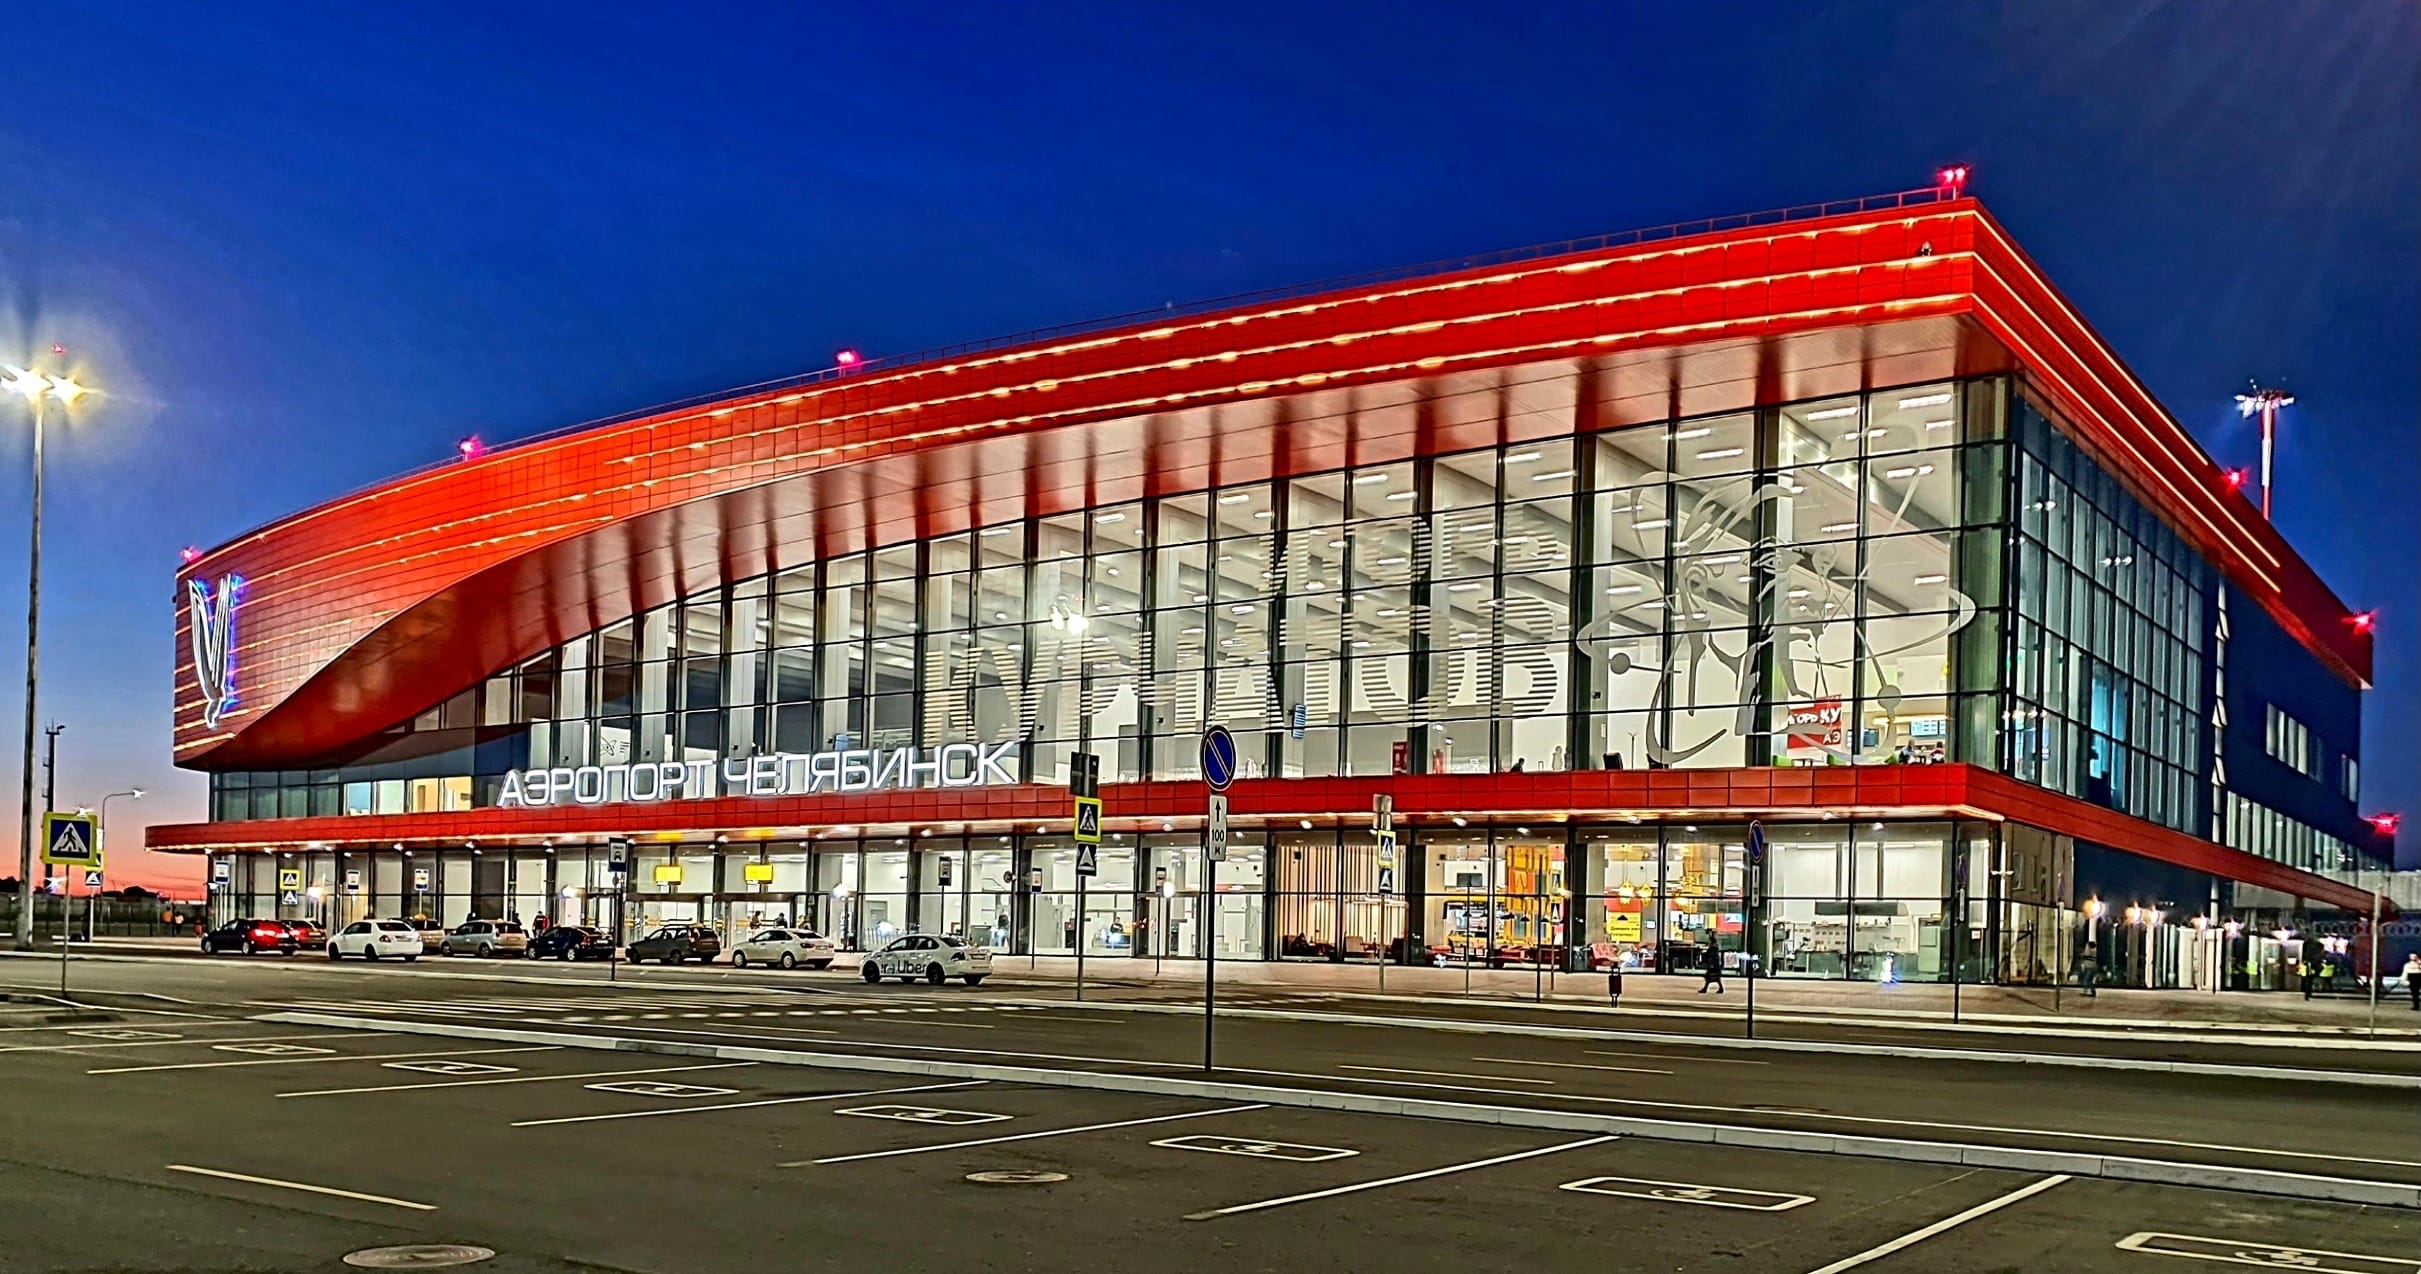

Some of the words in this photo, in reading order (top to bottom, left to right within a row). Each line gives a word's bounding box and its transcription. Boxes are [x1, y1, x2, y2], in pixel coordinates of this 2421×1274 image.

[924, 594, 1558, 745] КУРЧАТОВ
[497, 760, 716, 806] АЭРОПОРТ
[724, 742, 1018, 795] ЧЕЛЯБИНСК
[1212, 829, 1224, 841] 100
[898, 960, 926, 974] Uber
